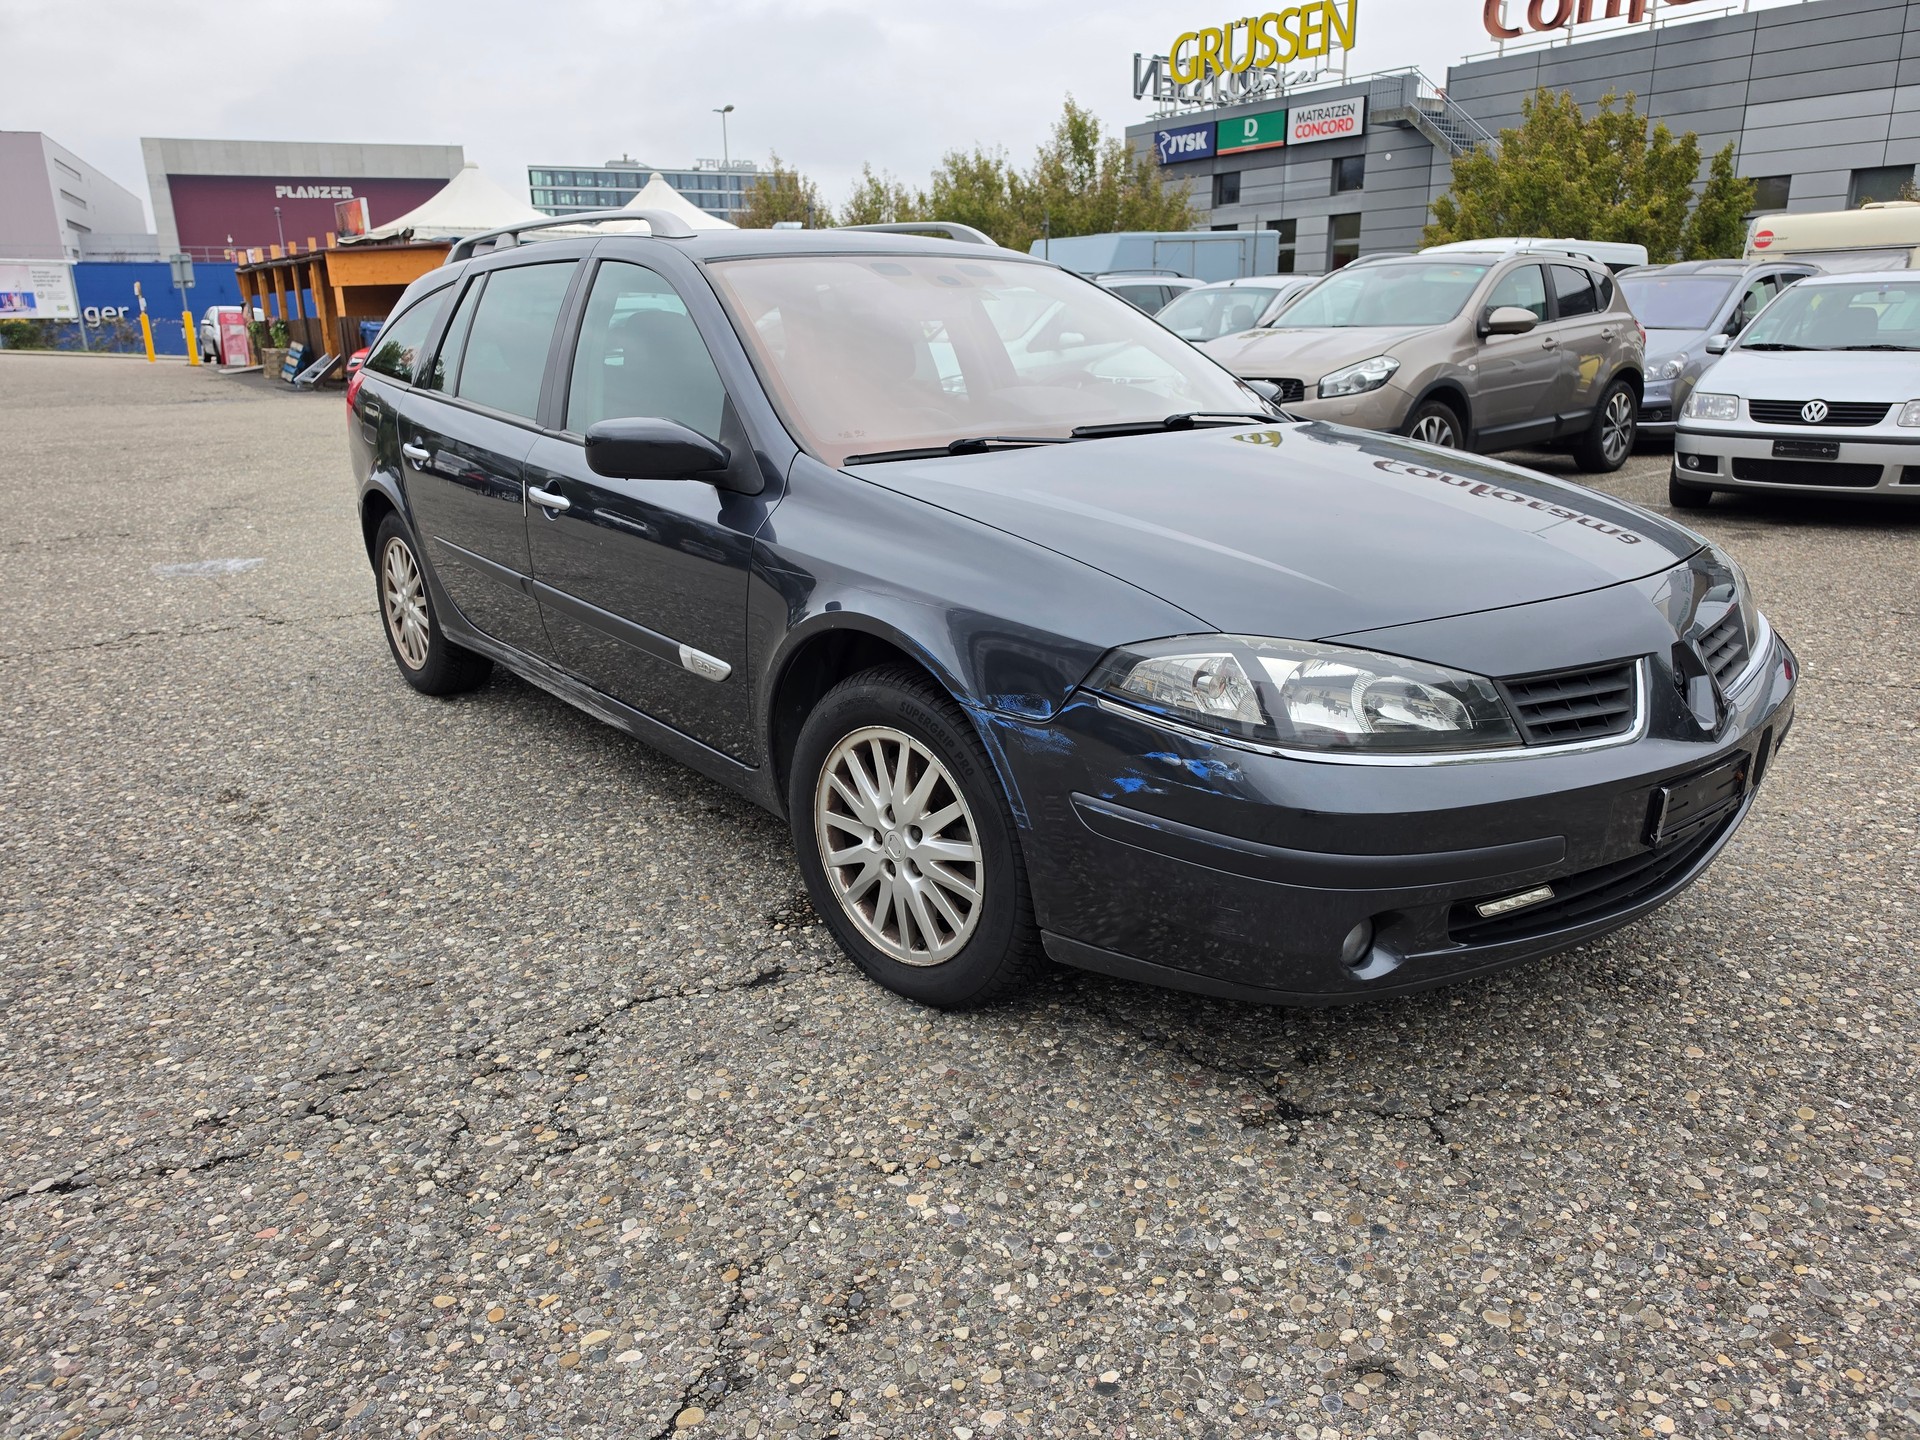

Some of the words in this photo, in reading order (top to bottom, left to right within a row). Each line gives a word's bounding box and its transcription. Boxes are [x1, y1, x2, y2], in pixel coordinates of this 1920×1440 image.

[1169, 0, 1358, 85] GRÜSSEN
[1296, 103, 1355, 124] MATRATZEN
[1244, 118, 1258, 137] D
[1295, 117, 1354, 139] CONCORD
[1168, 130, 1208, 154] JYSK
[275, 185, 354, 199] PLANZER
[899, 701, 955, 748] SUPERGRIP
[954, 751, 975, 776] PRO
